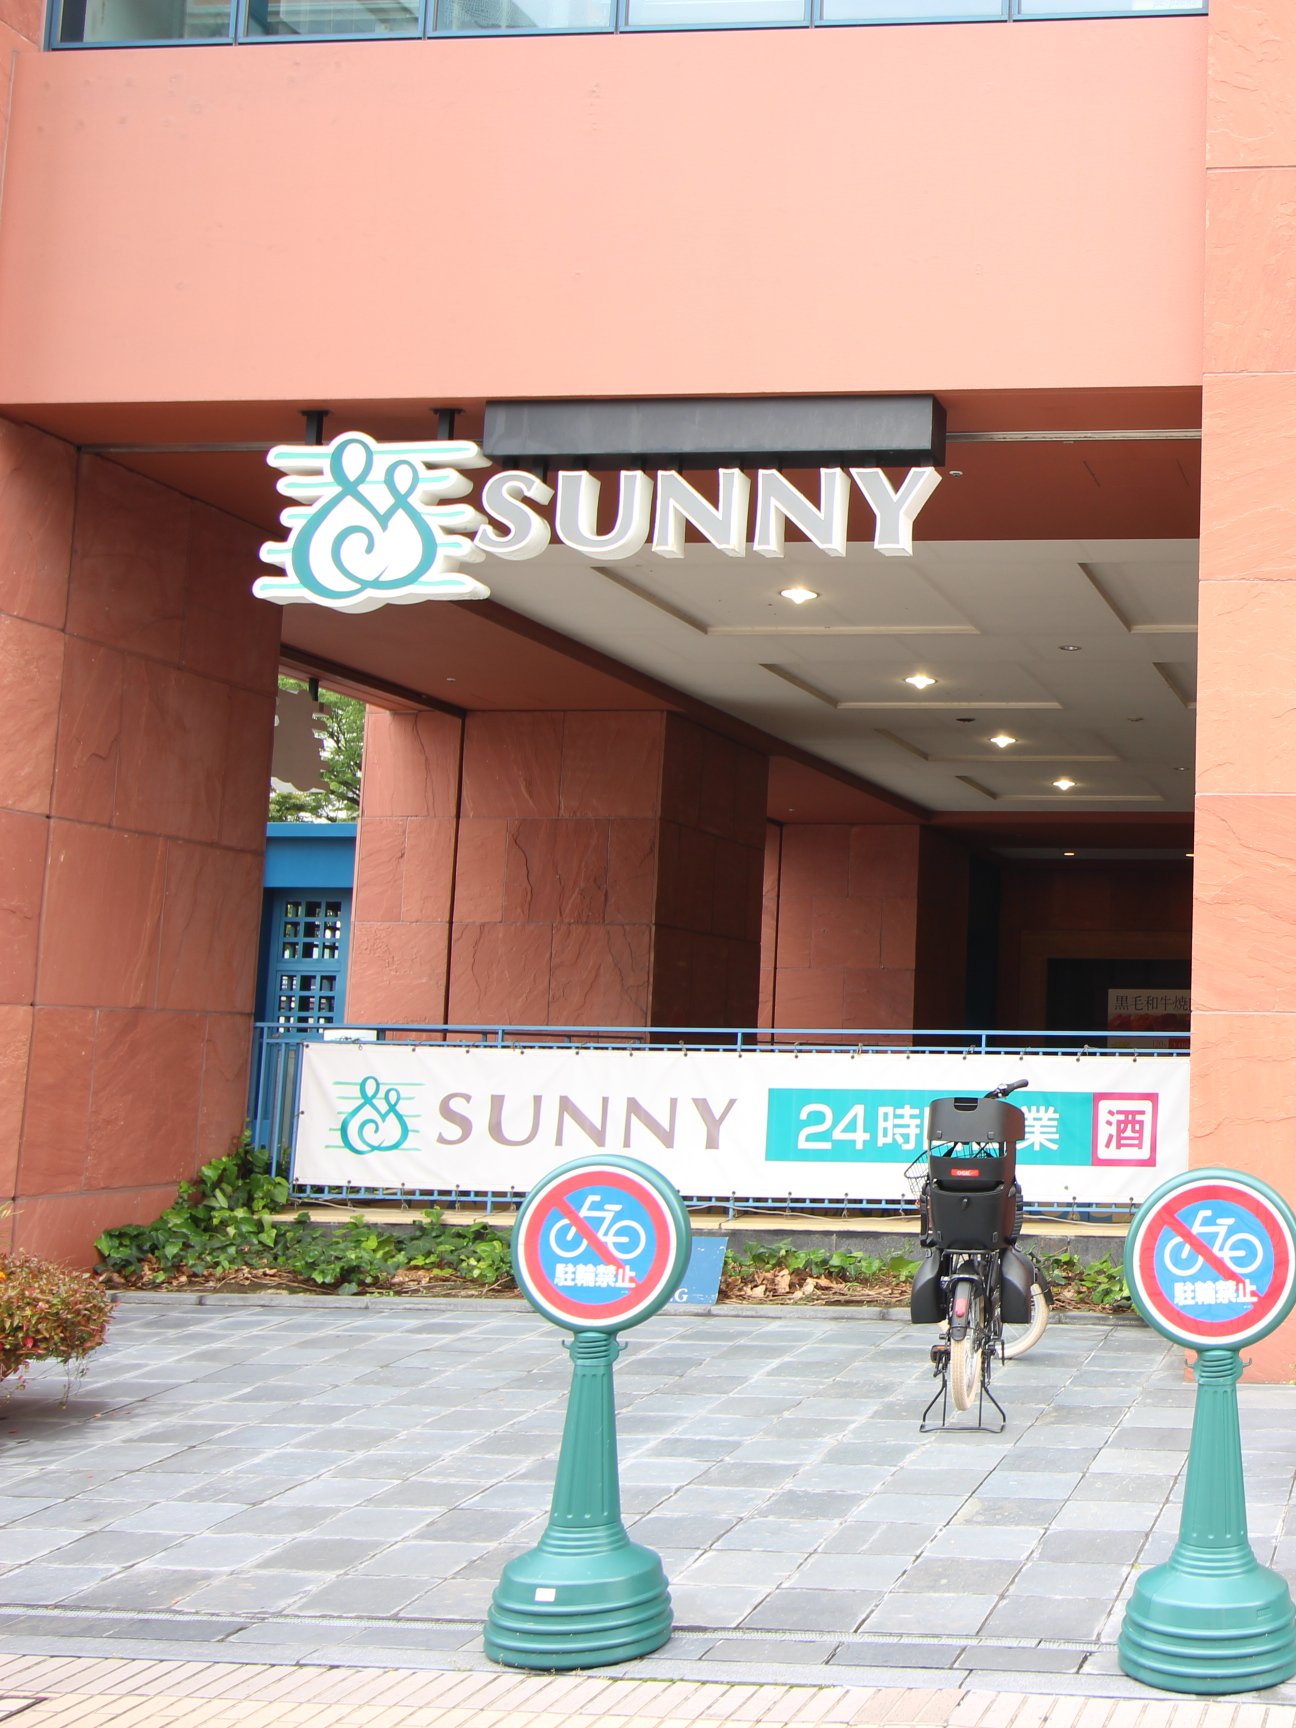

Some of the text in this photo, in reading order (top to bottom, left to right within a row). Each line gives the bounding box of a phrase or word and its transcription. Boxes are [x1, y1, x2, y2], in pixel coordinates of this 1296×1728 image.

[474, 467, 942, 560] SUNNY
[1112, 994, 1190, 1012] 黒毛和牛焼
[436, 1092, 738, 1150] SUNNY
[797, 1103, 1060, 1151] 24時業
[1104, 1109, 1147, 1151] 酒
[554, 1263, 636, 1288] 駐輪禁止
[1174, 1279, 1258, 1305] 駐輪禁止
